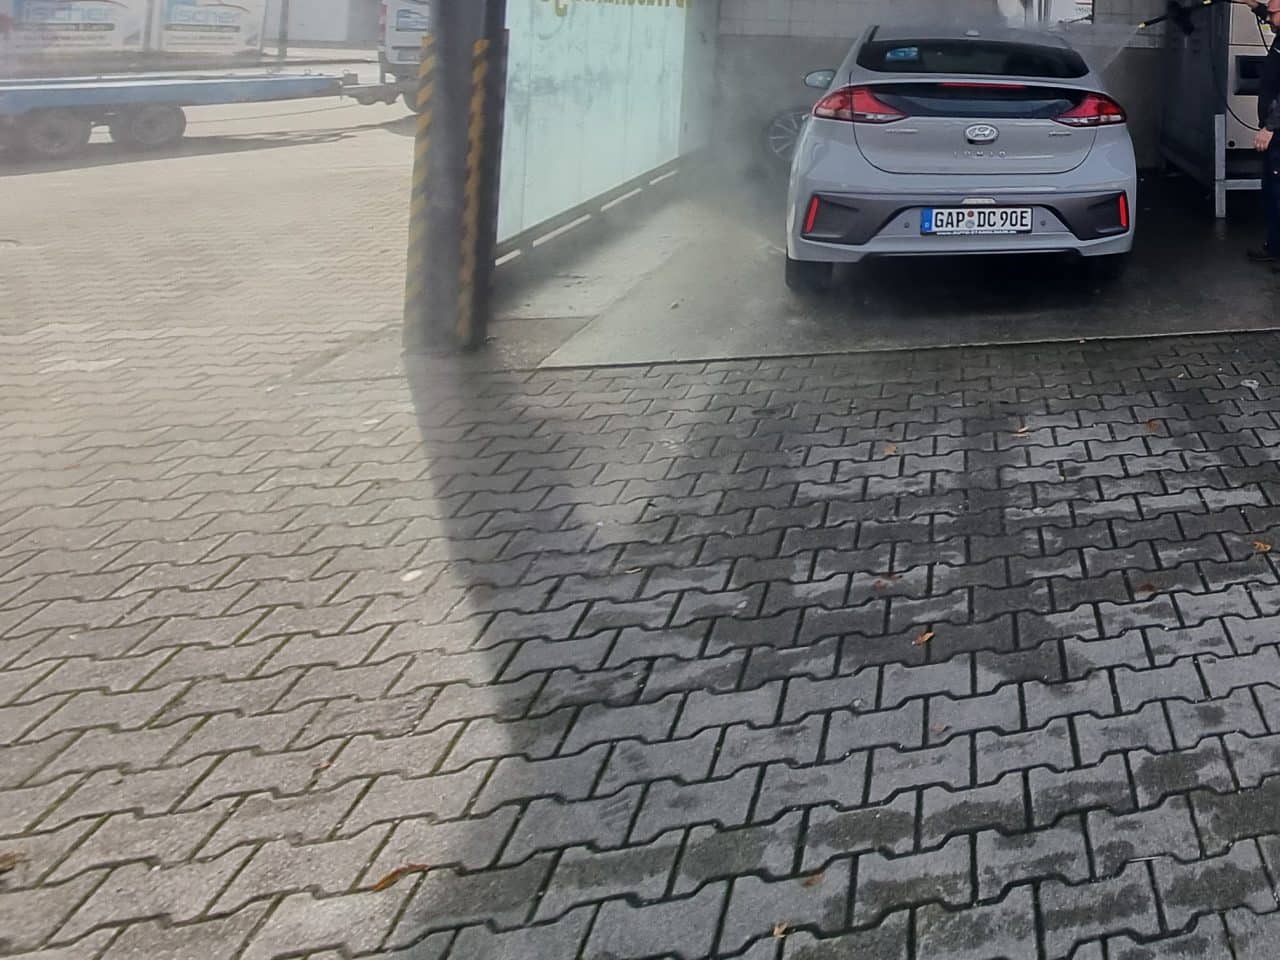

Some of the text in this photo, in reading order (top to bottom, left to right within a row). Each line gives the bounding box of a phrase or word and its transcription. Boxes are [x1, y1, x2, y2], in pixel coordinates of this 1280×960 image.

[935, 211, 965, 228] GAP
[977, 211, 996, 228] DC
[1000, 211, 1029, 228] 90E
